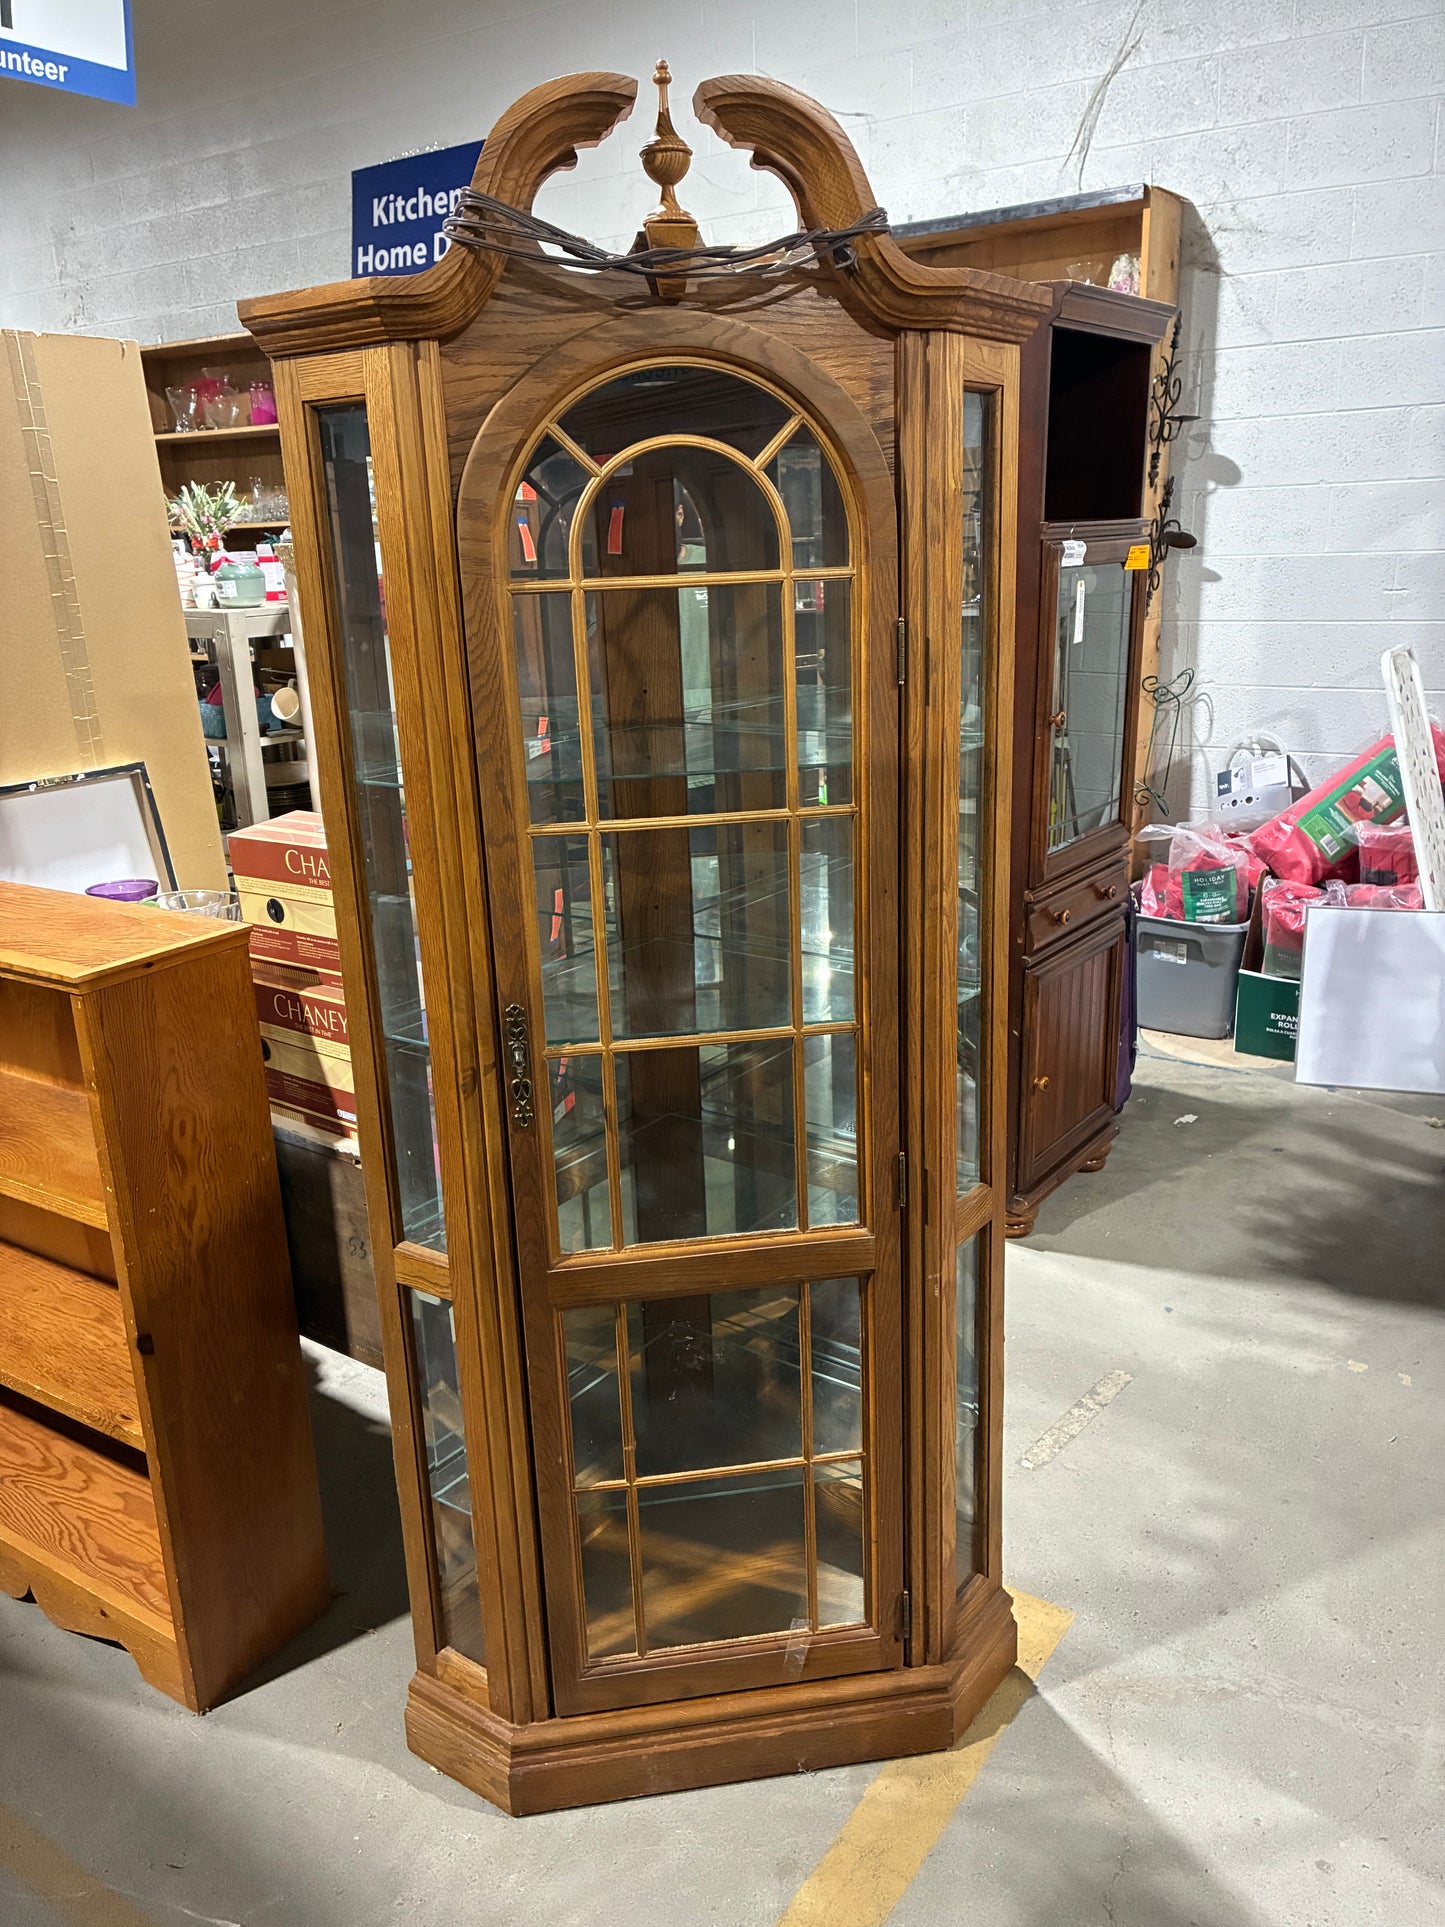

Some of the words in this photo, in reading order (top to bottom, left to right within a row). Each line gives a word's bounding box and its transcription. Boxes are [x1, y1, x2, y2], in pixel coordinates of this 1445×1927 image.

[357, 242, 428, 274] Home
[285, 849, 331, 879] CHA
[308, 878, 318, 886] THE
[274, 994, 347, 1034] CHANEY
